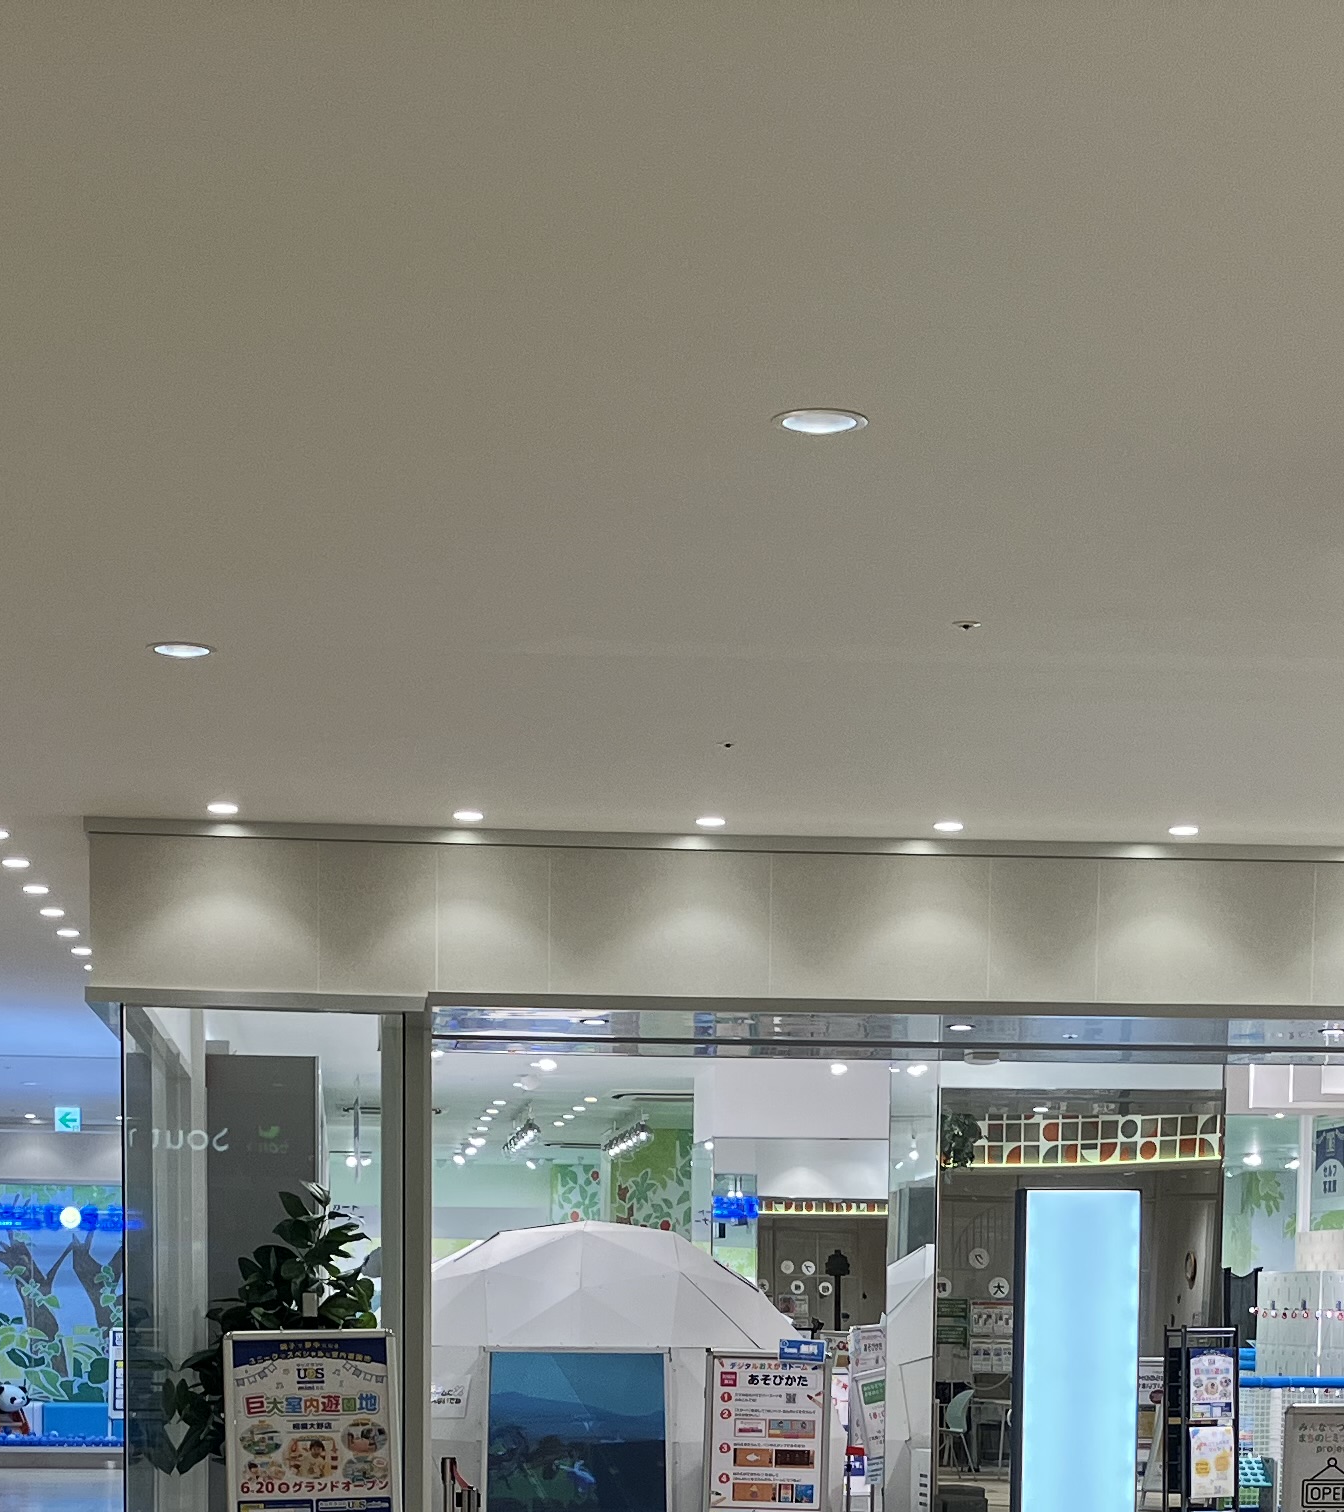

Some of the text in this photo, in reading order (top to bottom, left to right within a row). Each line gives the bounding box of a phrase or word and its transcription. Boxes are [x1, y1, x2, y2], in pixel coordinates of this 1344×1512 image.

[748, 1374, 808, 1387] あそびかた
[245, 1393, 378, 1415] 巨大室内遊園地
[292, 1480, 390, 1493] グランドオープン
